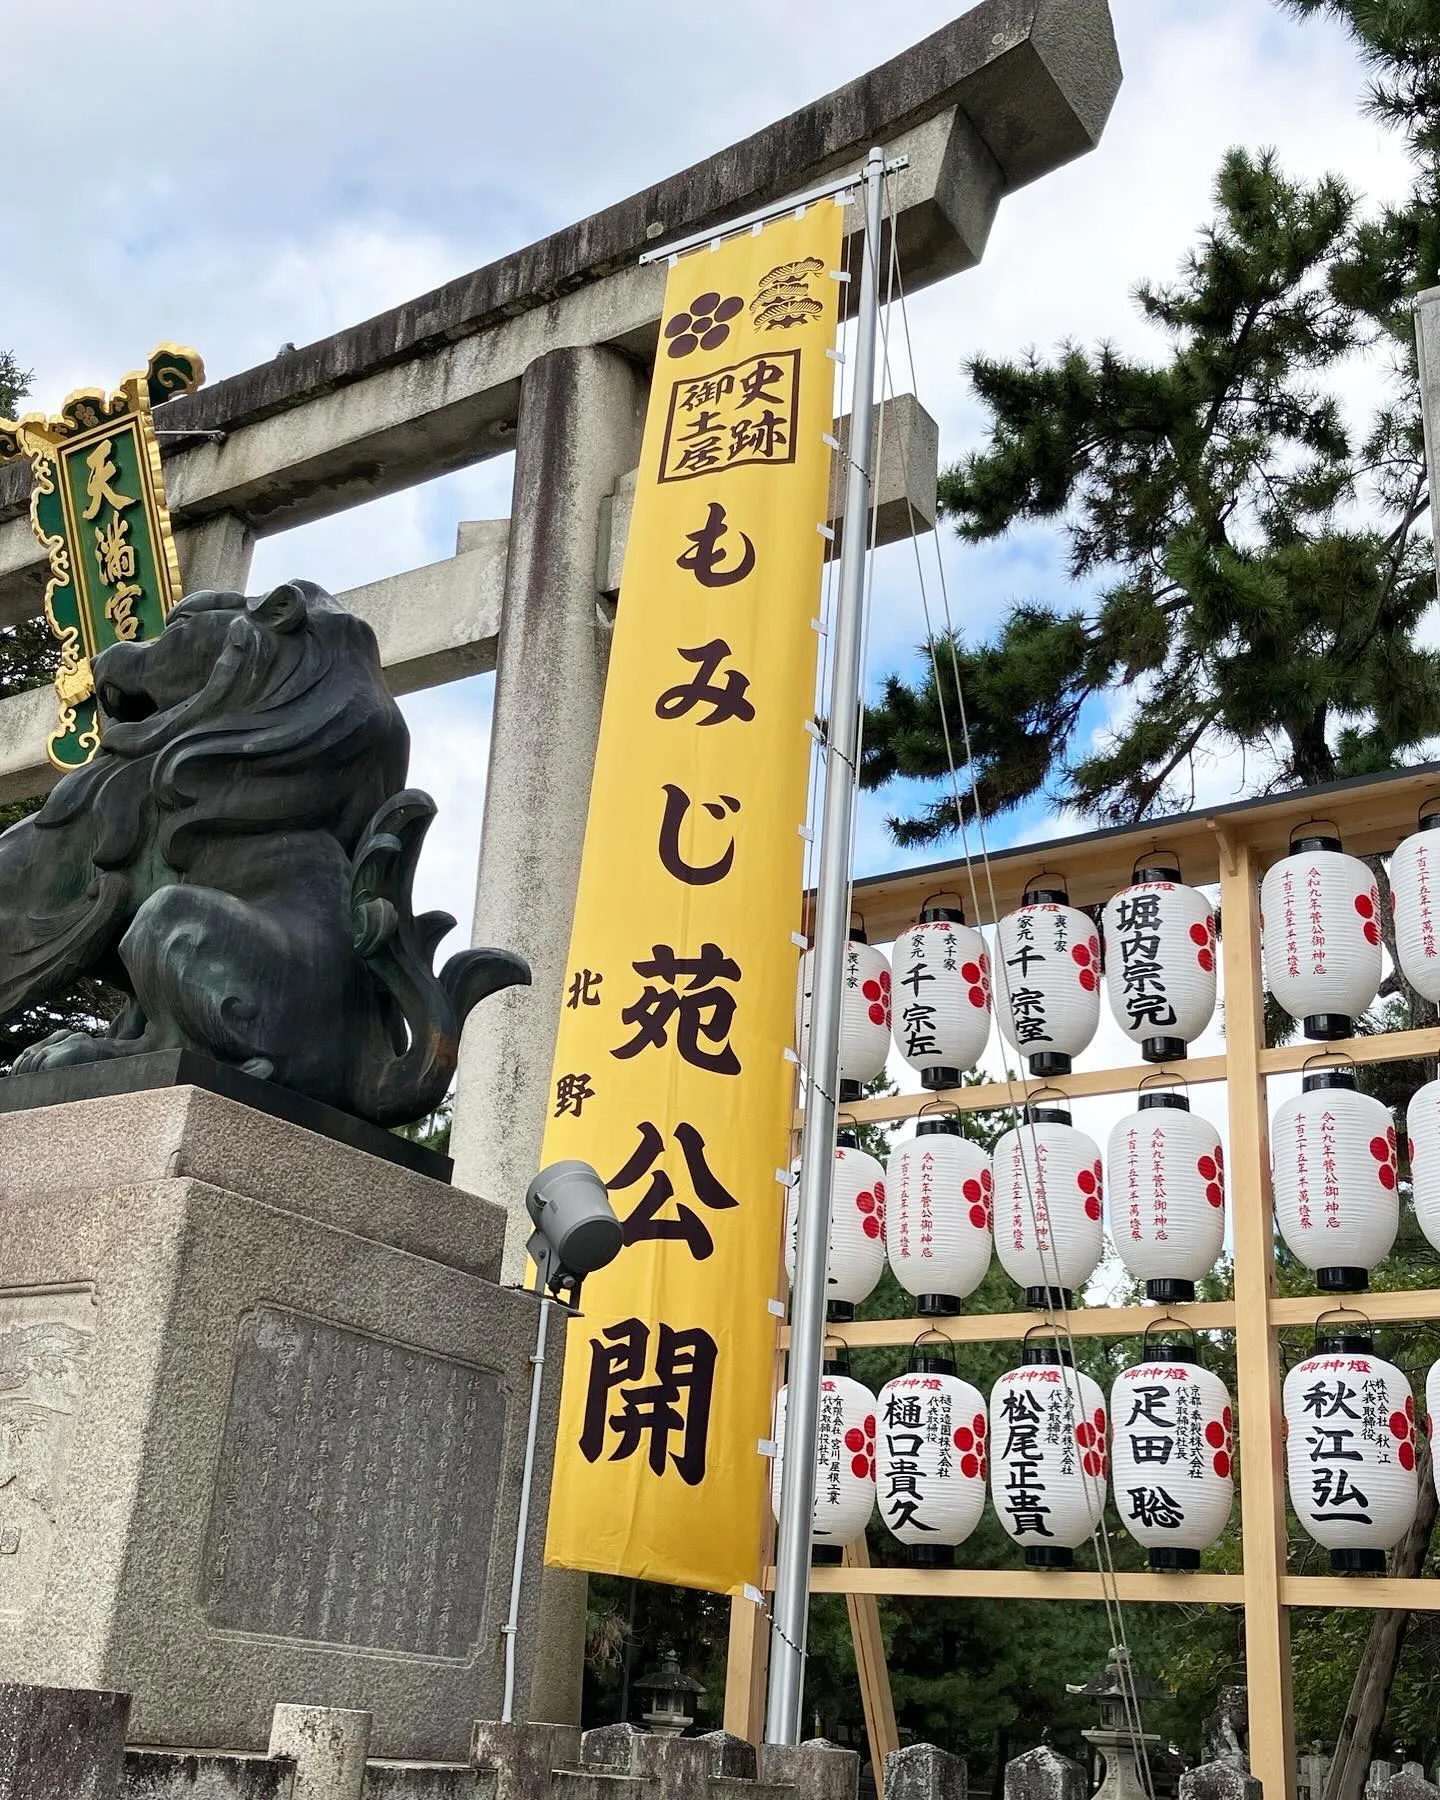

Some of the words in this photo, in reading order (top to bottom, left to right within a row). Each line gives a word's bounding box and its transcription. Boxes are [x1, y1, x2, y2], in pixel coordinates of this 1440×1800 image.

[673, 374, 735, 472] 御土居
[727, 359, 788, 461] 史跡
[911, 934, 926, 959] 家元
[943, 932, 958, 972] 表千家
[1017, 915, 1034, 942] 家元
[1053, 914, 1068, 953] 裏千家
[1115, 893, 1178, 1031] 堀内宗完
[577, 502, 756, 1486] もみじ苑公開
[1044, 1388, 1063, 1446] 代表取締役
[1174, 1386, 1190, 1460] 代表取締役社長
[1302, 1380, 1373, 1526] 秋江弘一
[1360, 1379, 1378, 1442] 代表取締役
[882, 1392, 941, 1531] 樋口貴久
[1000, 1389, 1055, 1538] 松尾正貴
